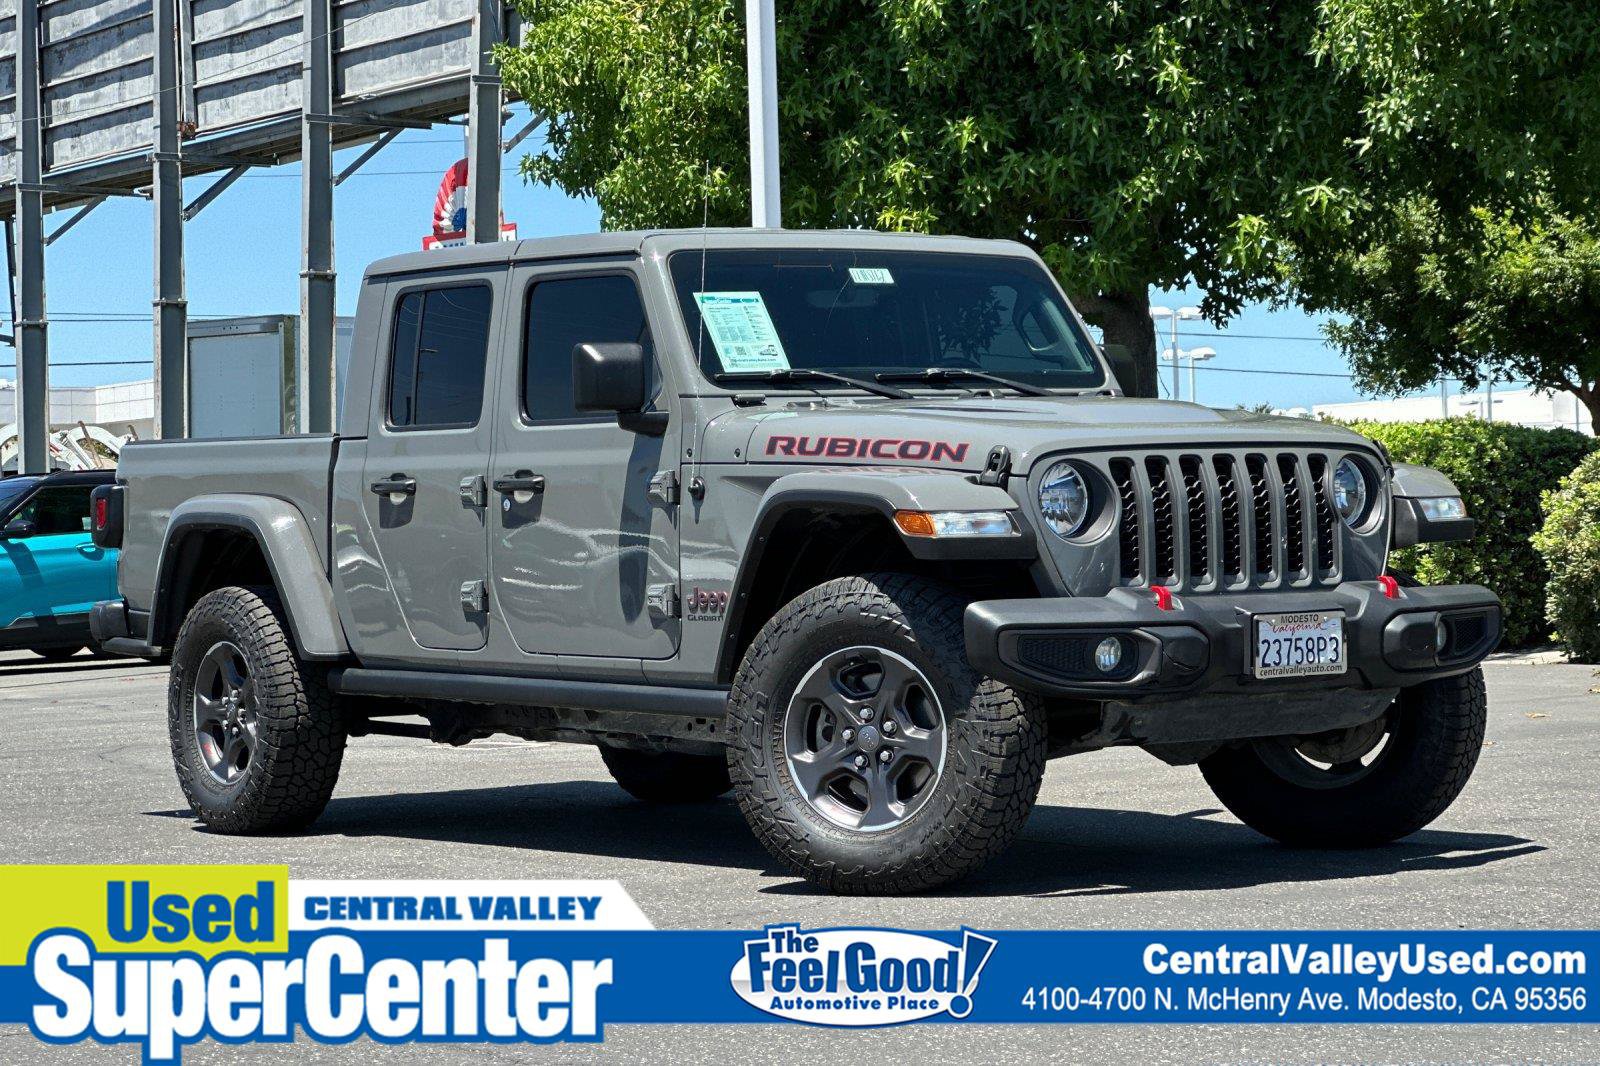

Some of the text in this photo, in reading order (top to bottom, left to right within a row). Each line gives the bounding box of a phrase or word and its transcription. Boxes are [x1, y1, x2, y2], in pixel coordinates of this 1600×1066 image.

[765, 436, 970, 463] RUBICON
[687, 586, 728, 614] Jeep
[1273, 622, 1328, 635] California
[1281, 614, 1319, 623] MODESTO
[1261, 636, 1339, 667] 23758P3
[1260, 665, 1343, 677] centralvalleyauto.com
